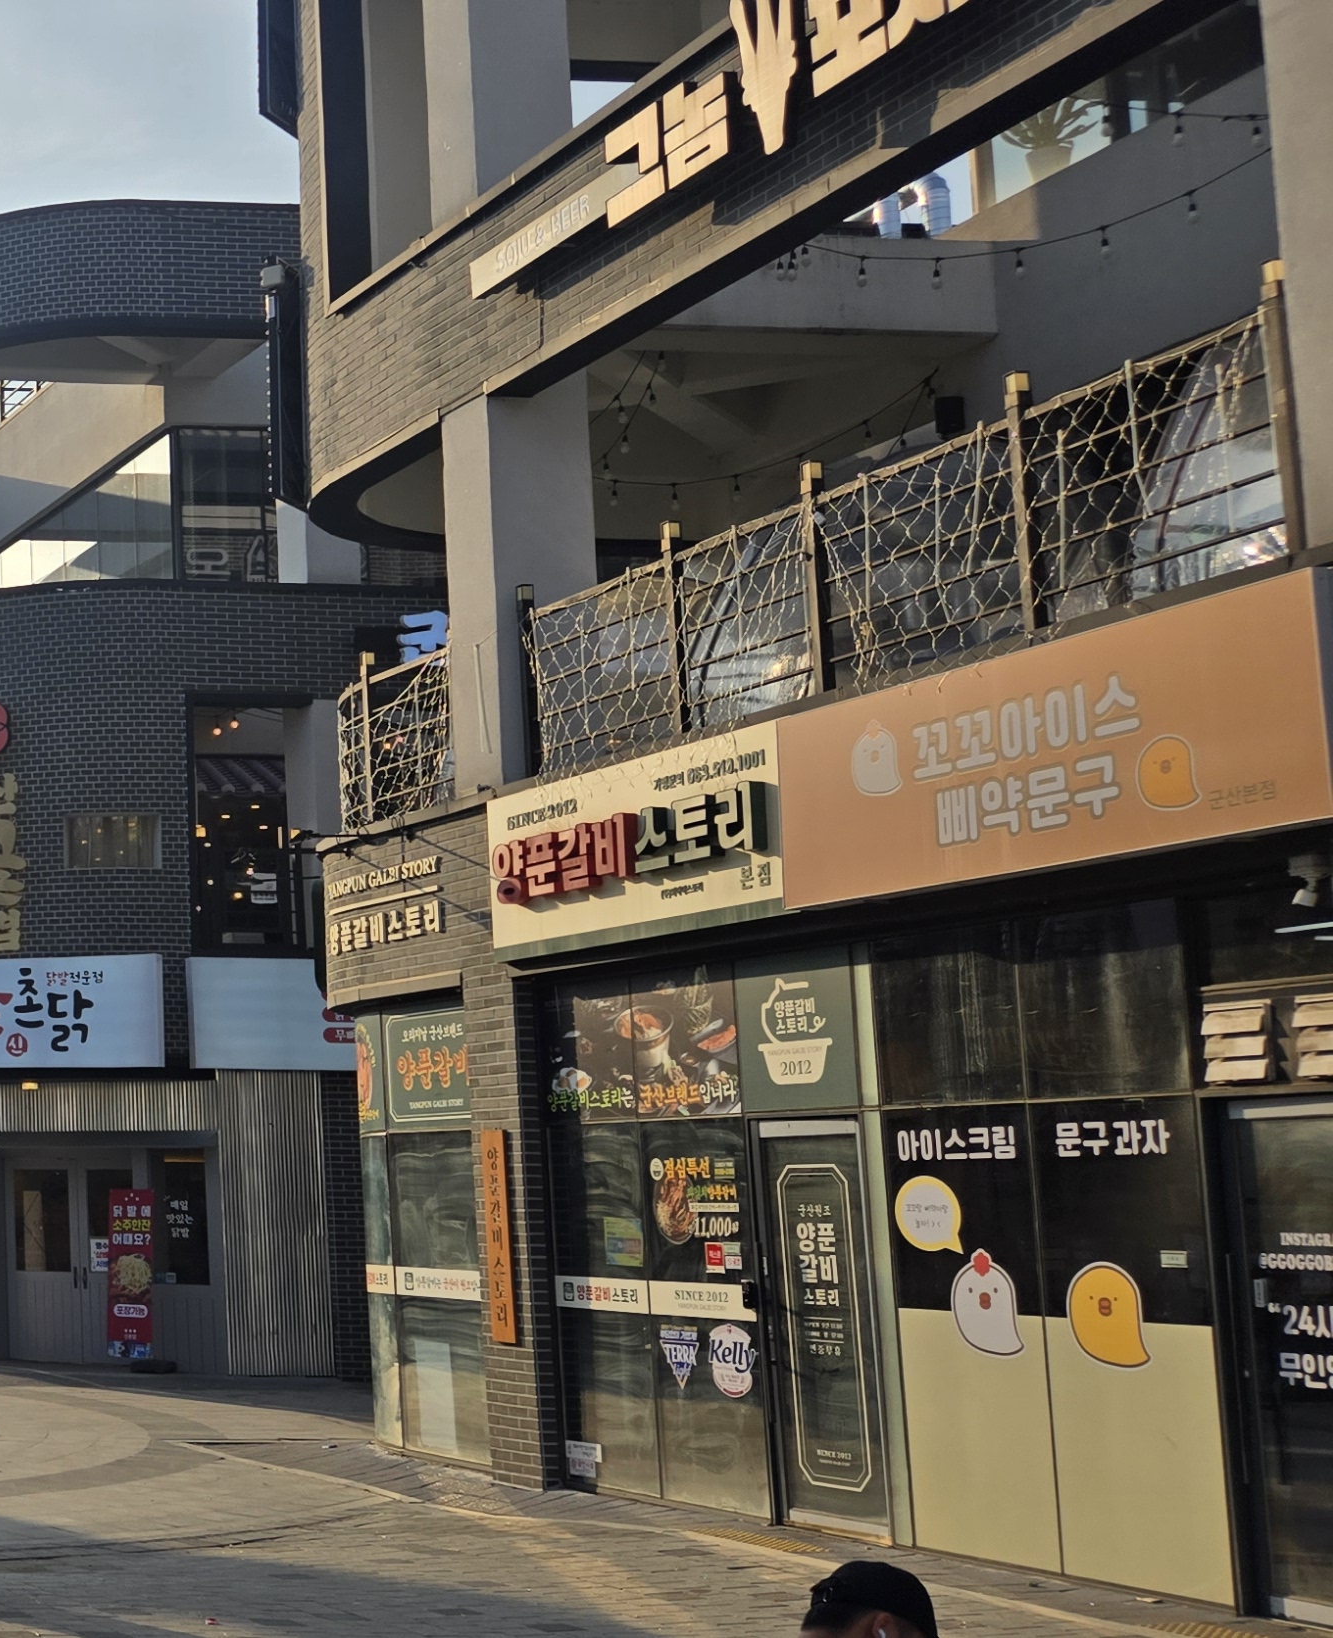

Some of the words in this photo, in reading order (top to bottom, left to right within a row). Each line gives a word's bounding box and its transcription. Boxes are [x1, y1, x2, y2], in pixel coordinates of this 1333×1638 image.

[605, 71, 729, 228] 그놈
[495, 237, 530, 275] SOJU
[550, 193, 591, 240] BEER
[911, 672, 1140, 781] 꼬꼬아이스
[935, 751, 1121, 848] 삐약문구
[1209, 780, 1276, 811] 군산본점
[505, 809, 547, 832] SINCE
[545, 799, 578, 825] 2012
[367, 867, 400, 889] GALBI
[399, 855, 439, 881] STORY
[46, 971, 104, 986] 닭발전문점
[773, 997, 815, 1016] 양푼갈비
[775, 1014, 808, 1035] 스토리
[780, 1059, 813, 1076] 2012
[896, 1124, 1017, 1162] 아이스크림
[1055, 1122, 1110, 1159] 문구
[1113, 1119, 1170, 1156] 과자
[663, 1156, 711, 1180] 점심특선
[486, 1146, 511, 1330] 양푼갈비스토리
[795, 1222, 837, 1252] 양푼
[798, 1253, 839, 1286] 갈비
[673, 1287, 704, 1302] SINCE
[704, 1290, 730, 1304] 2012
[803, 1287, 841, 1308] 스토리
[661, 1341, 697, 1367] TERRA
[711, 1339, 757, 1374] Kelly
